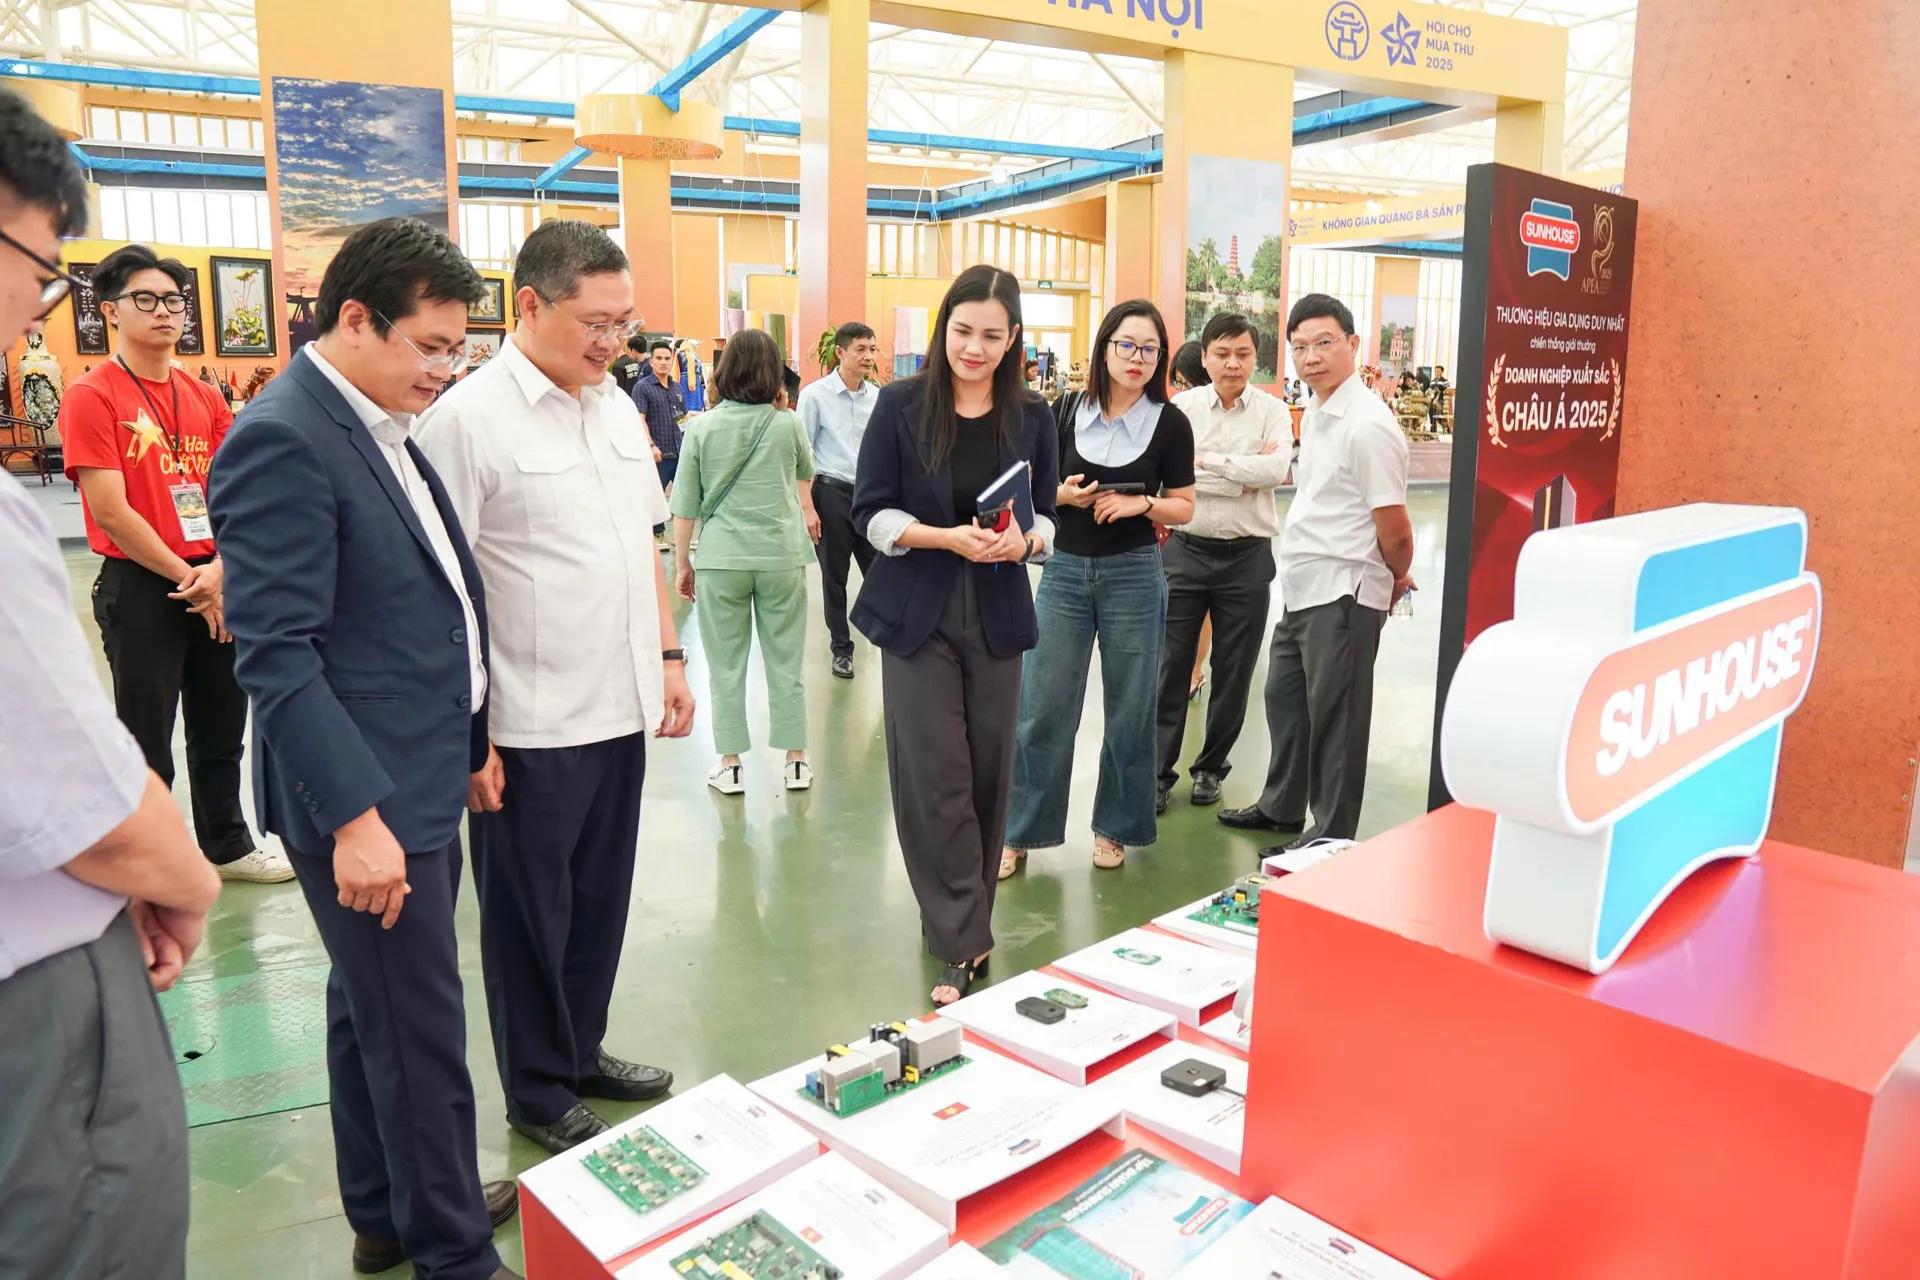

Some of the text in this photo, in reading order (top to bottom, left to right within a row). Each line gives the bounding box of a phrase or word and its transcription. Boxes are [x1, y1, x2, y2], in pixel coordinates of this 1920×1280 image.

[1426, 56, 1453, 70] 2025
[1355, 214, 1377, 227] GIAN
[1526, 221, 1575, 244] SUNHOUSE
[1496, 306, 1625, 332] THƯƠNG HIỆU GIA DỤNG DUY NHẤT
[1530, 336, 1547, 349] chiến
[1505, 361, 1610, 388] DOANH NGHIỆP XUẤT SẮC
[1502, 392, 1608, 432] CHÂU Á 2025
[1596, 614, 1808, 777] SUNHOUSE
